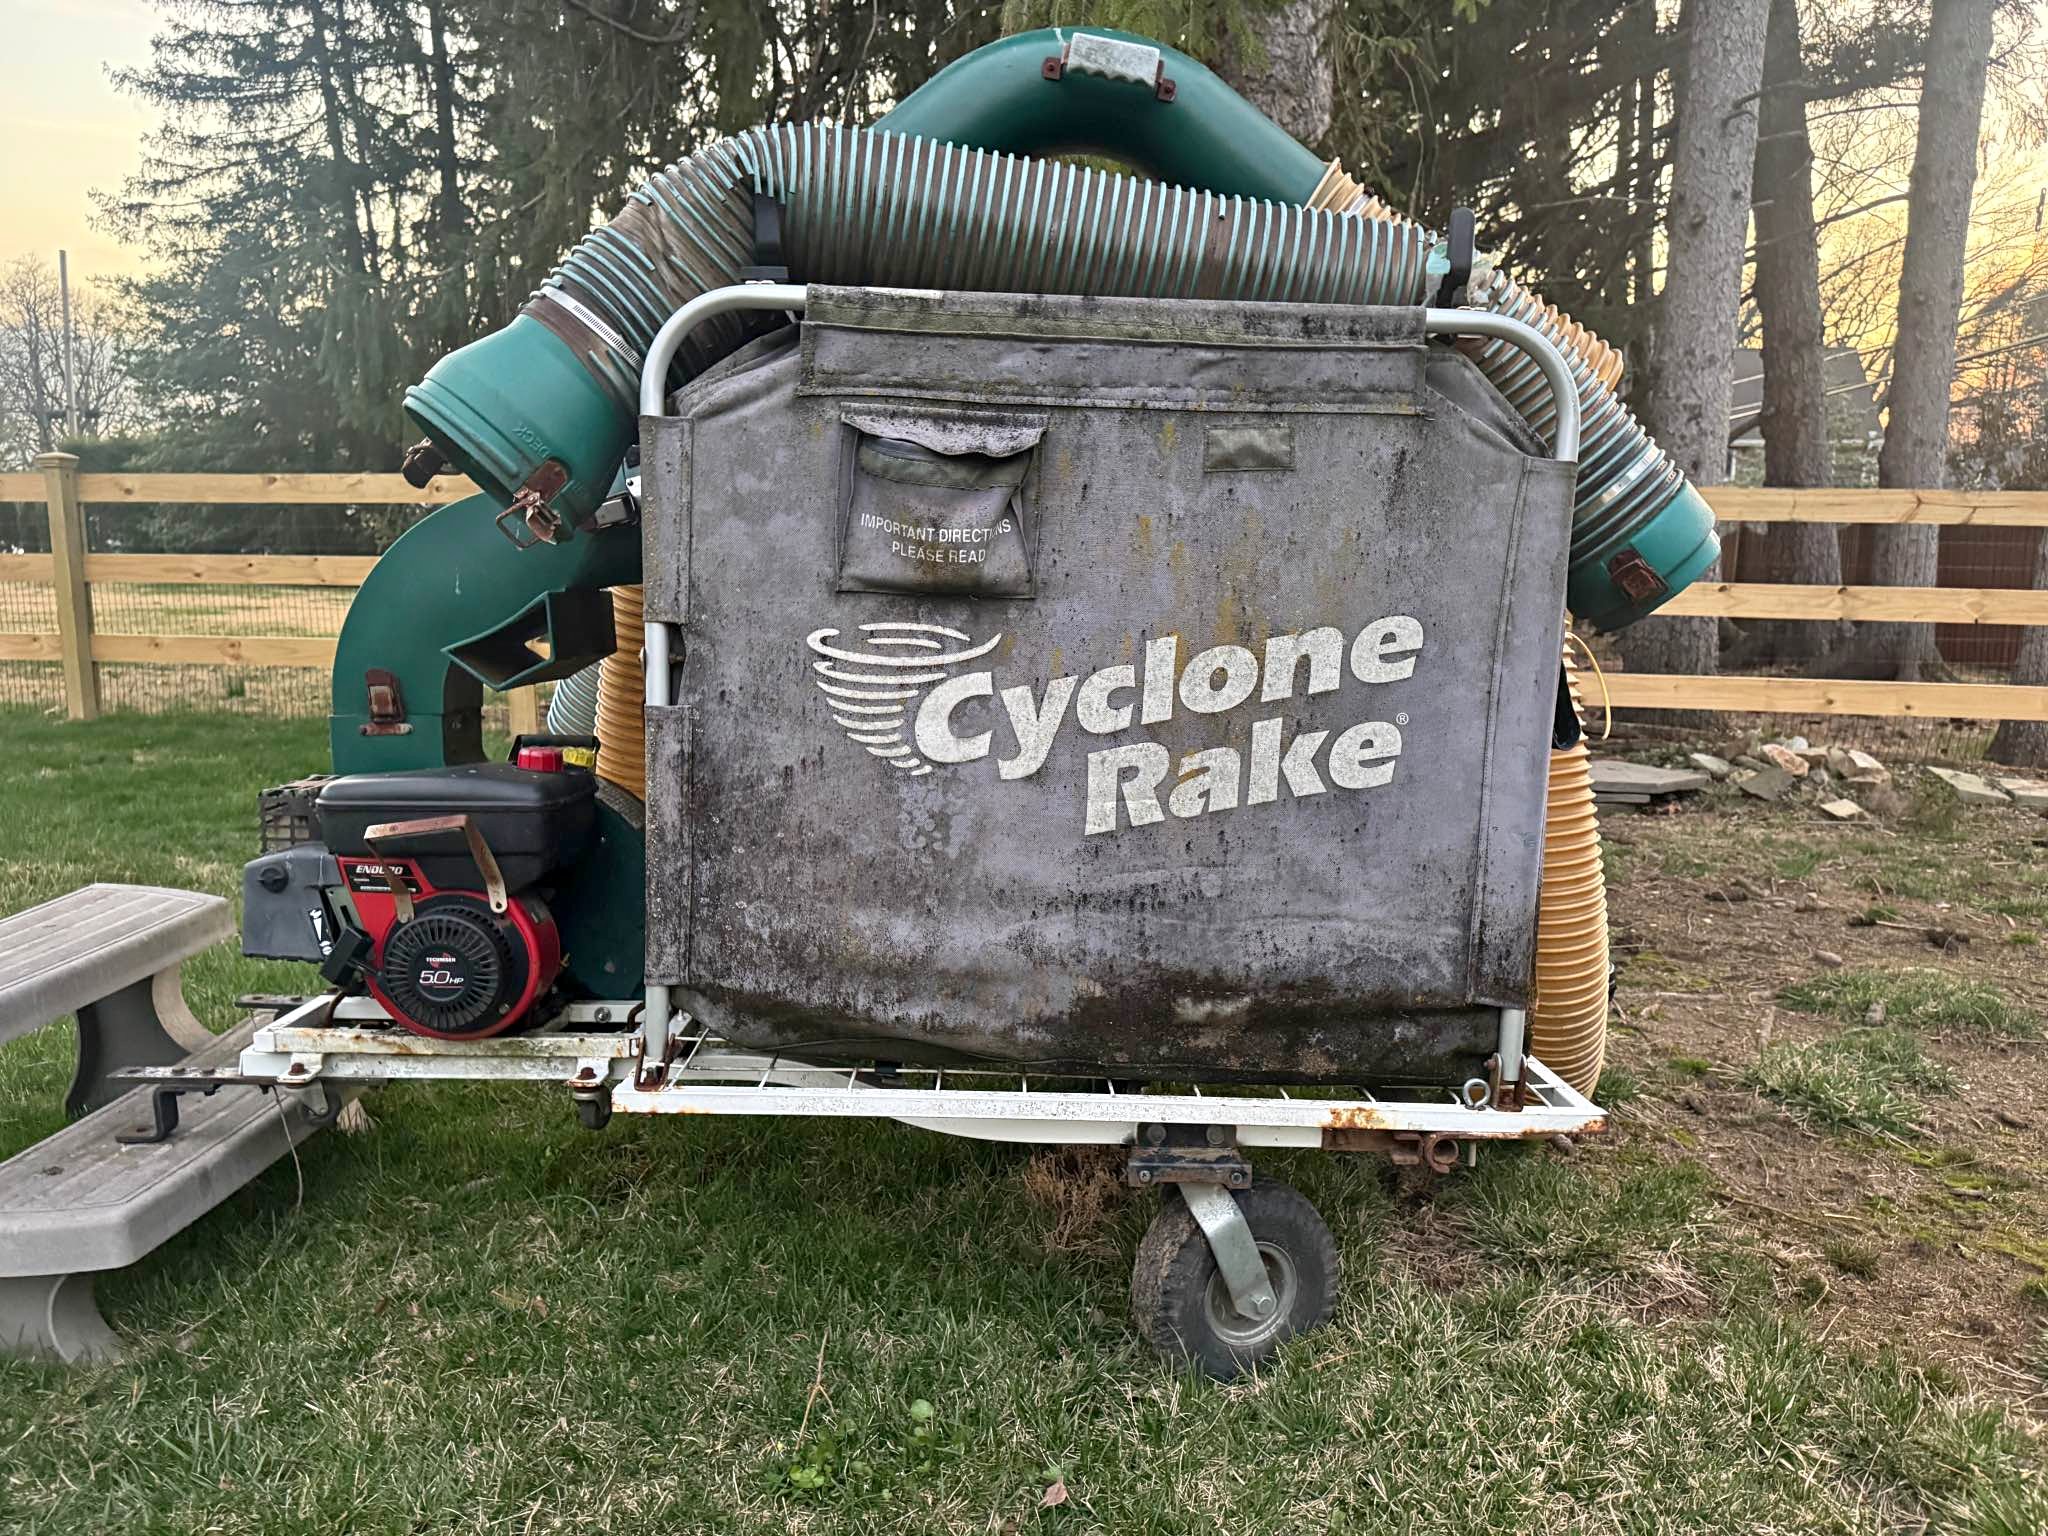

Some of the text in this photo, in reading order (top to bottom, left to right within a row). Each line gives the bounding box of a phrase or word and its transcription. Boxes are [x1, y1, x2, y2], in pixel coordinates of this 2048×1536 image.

[861, 513, 935, 542] IMPORTANT
[892, 541, 986, 563] PLEASE READ
[914, 615, 1425, 780] Cyclone
